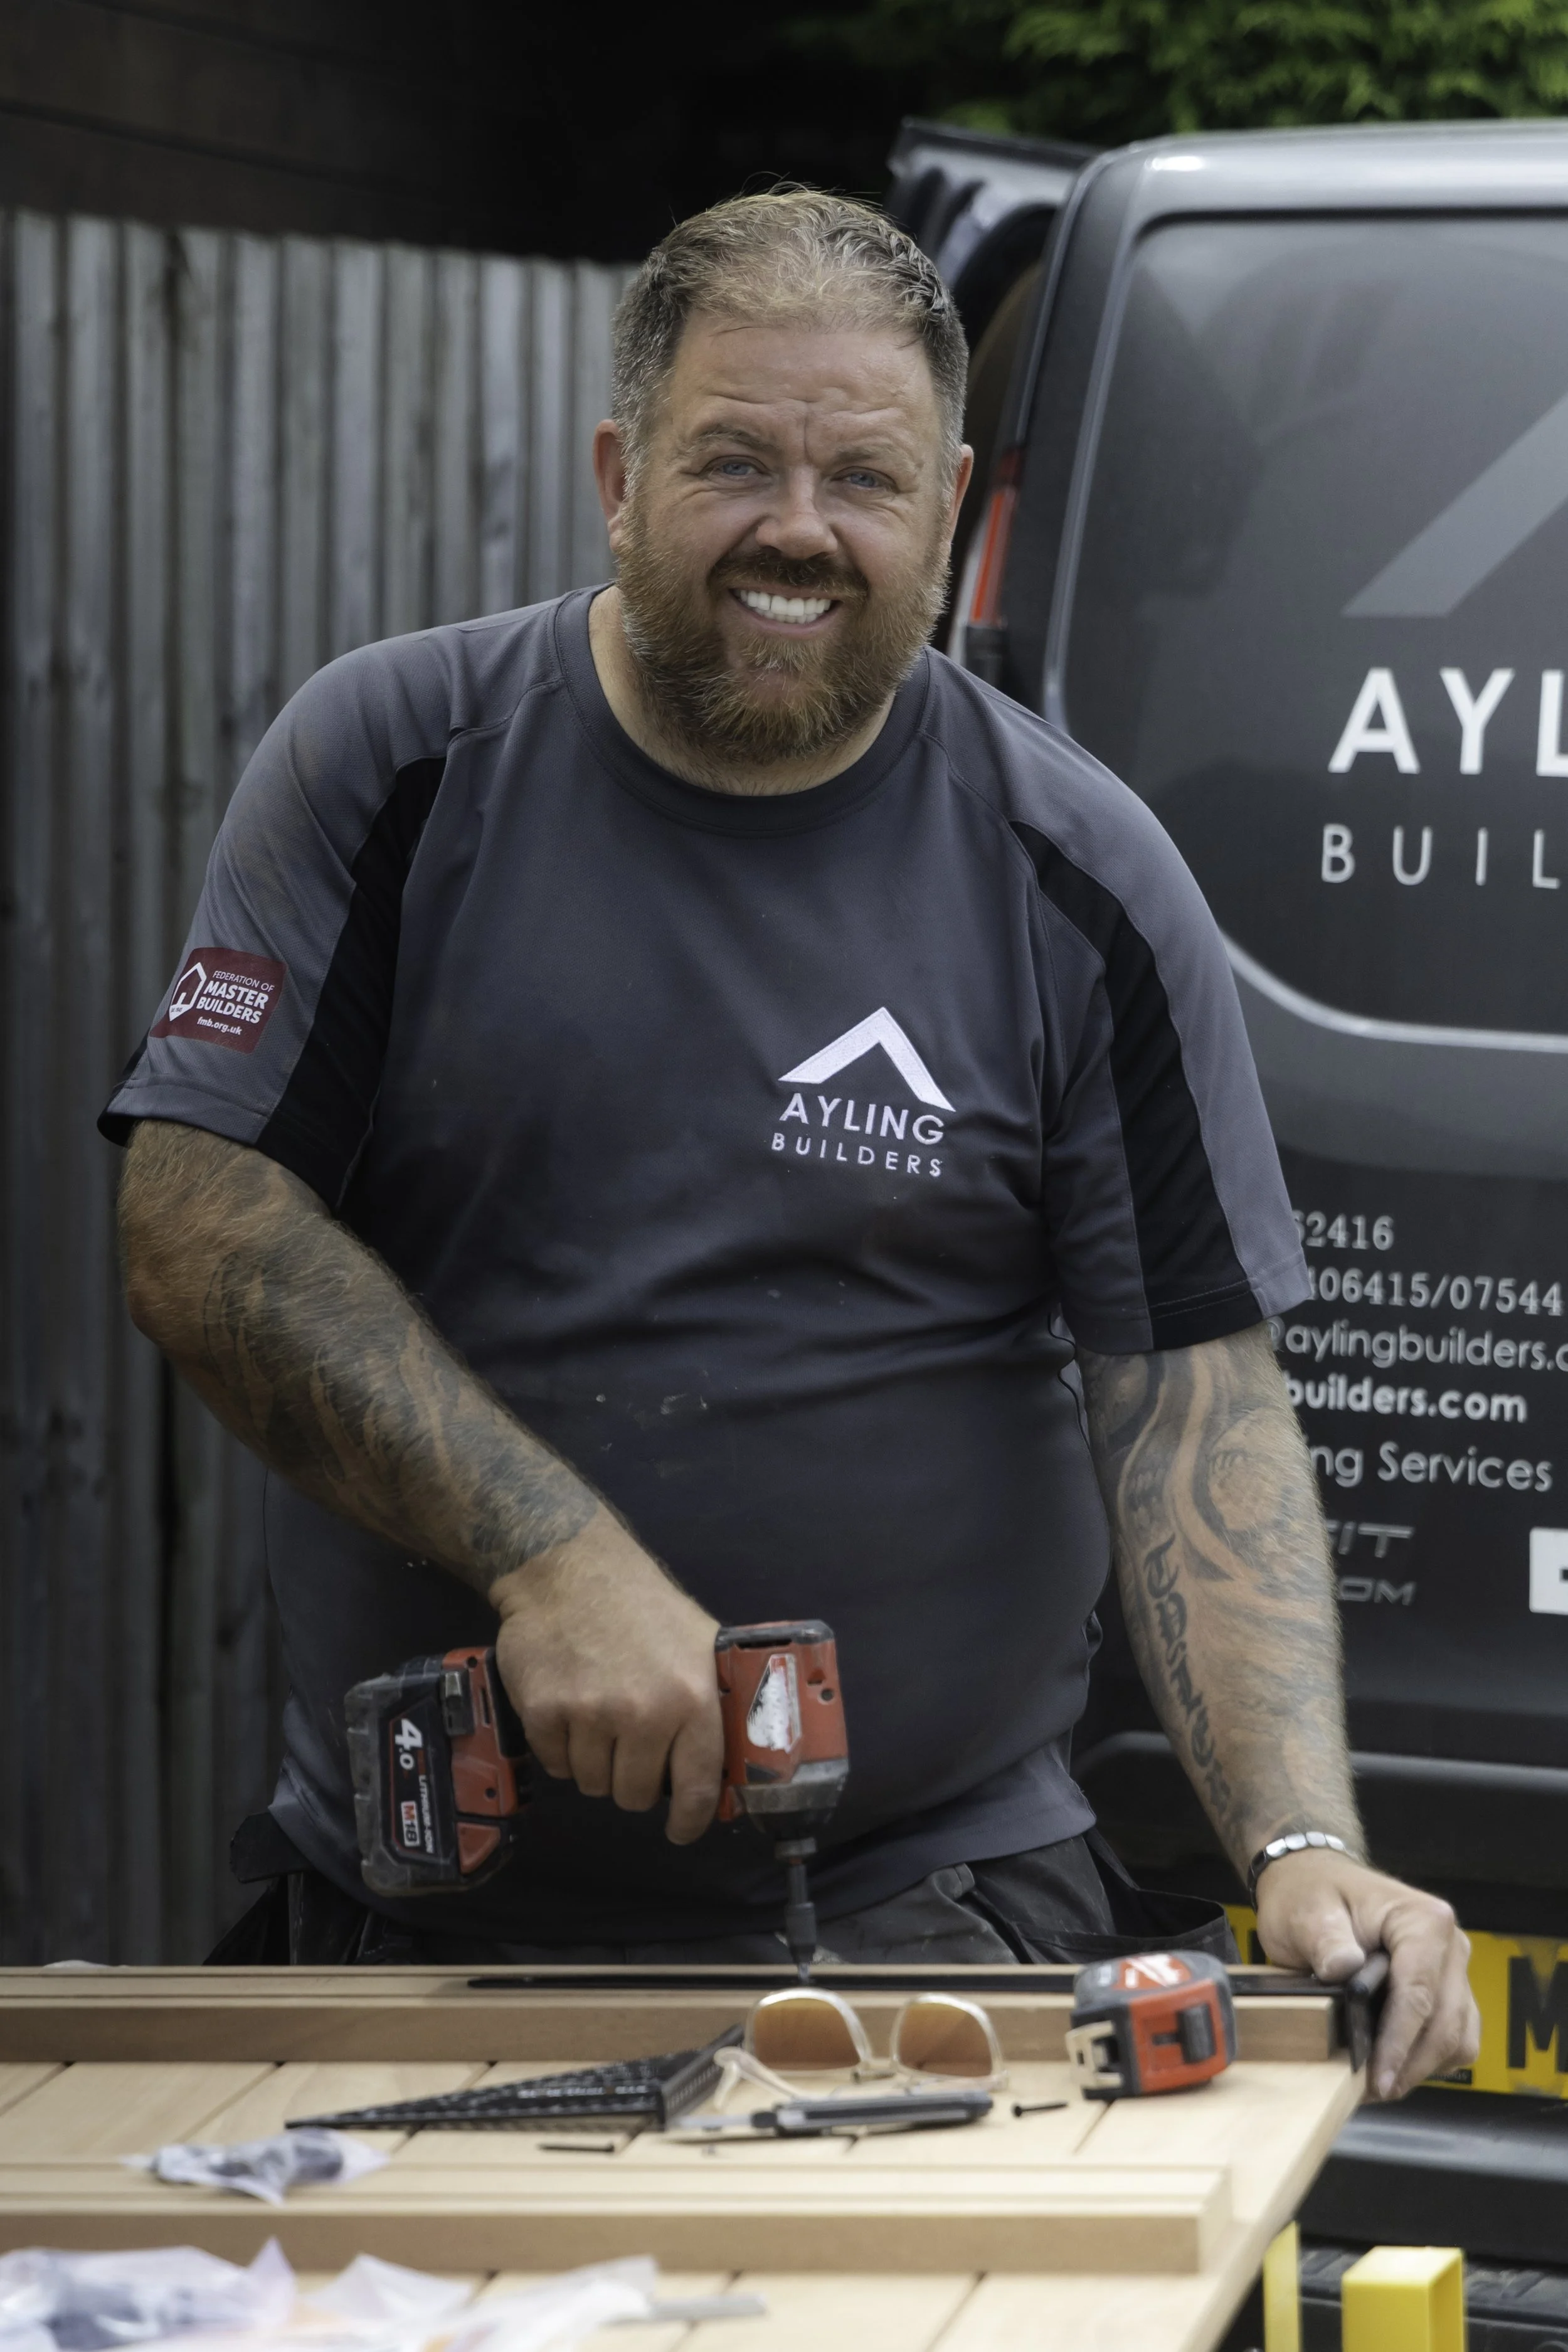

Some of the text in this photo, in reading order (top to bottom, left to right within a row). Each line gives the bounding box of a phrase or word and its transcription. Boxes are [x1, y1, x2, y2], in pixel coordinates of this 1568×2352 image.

[1328, 666, 1568, 778] AYL
[1321, 823, 1560, 889] BUIL
[203, 980, 269, 1010] MASTER
[212, 970, 275, 992] FEDERATION OF
[196, 997, 262, 1024] BUILDERS
[197, 1017, 243, 1035] fmb.org.uk
[779, 1093, 945, 1145] AYLING
[771, 1132, 943, 1177] BUILDERS
[1377, 1441, 1553, 1493] Services
[395, 1718, 424, 1771] 4.0
[403, 1804, 418, 1843] M18
